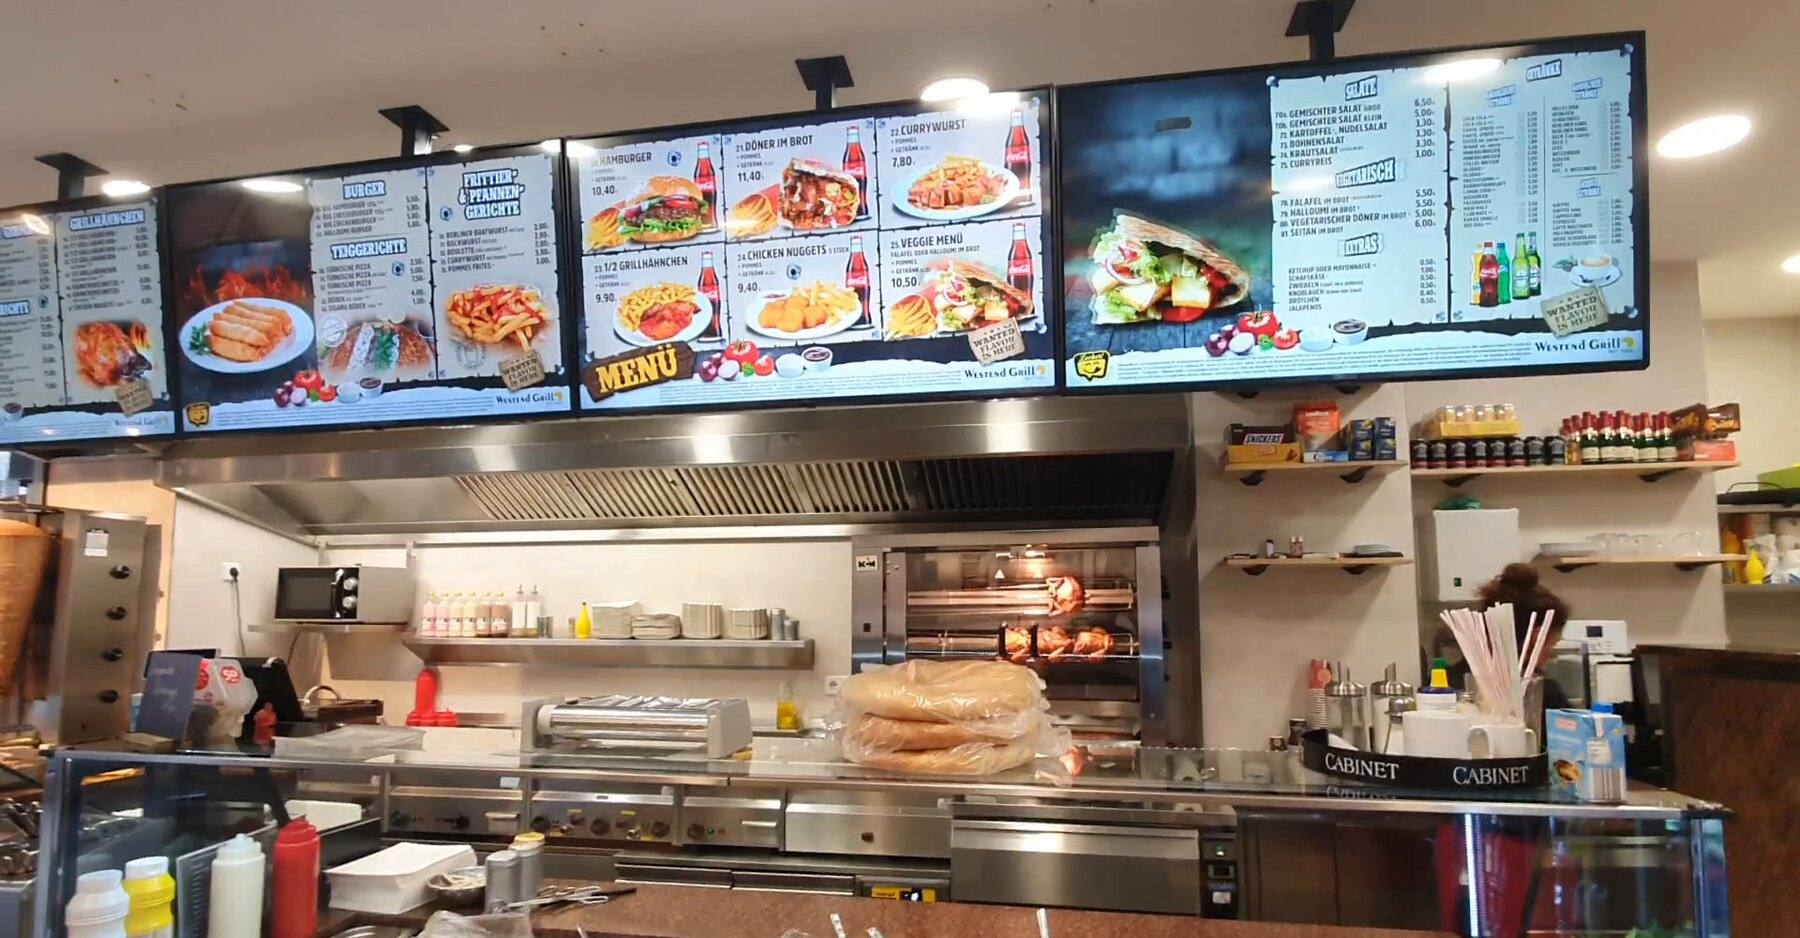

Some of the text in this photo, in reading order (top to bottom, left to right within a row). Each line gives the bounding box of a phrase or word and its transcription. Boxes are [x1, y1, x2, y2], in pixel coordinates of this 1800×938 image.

[1290, 106, 1336, 118] GEMISCHTER
[1338, 104, 1362, 114] SALAT
[901, 119, 966, 135] CURRYWURST
[1290, 116, 1337, 128] GEMISCHTER
[1338, 114, 1362, 124] SALAT
[1338, 123, 1388, 134] NUDELSALAT
[745, 138, 775, 151] DÖNER
[777, 140, 788, 148] IM
[790, 135, 813, 146] BROT
[1290, 136, 1344, 148] BOHNENSALAT
[600, 152, 652, 166] HAMBURGER
[1290, 147, 1338, 158] KRAUTSALAT
[1290, 158, 1332, 168] CURRYREIS
[344, 181, 385, 199] BURGER
[1290, 198, 1322, 206] FALAFEL
[466, 200, 520, 219] GERICHTE
[1290, 207, 1329, 216] HALLOUMI
[1290, 216, 1350, 226] VEGETARISCHER
[474, 226, 508, 236] BRATWURST
[1290, 228, 1316, 236] SEITAN
[901, 237, 934, 248] VEGGIE
[936, 232, 963, 246] MENÜ
[332, 240, 406, 258] TEIGGERICHTE
[748, 248, 784, 260] CHICKEN
[786, 245, 826, 256] NUGGETS
[448, 264, 472, 273] POMMES
[604, 263, 617, 272] 1/2
[620, 256, 688, 270] GRILLHÄHNCHEN
[1548, 296, 1596, 316] WANTED
[973, 328, 1016, 348] WANTED
[596, 344, 678, 394] MENÜ
[1245, 434, 1282, 444] SNICKERS
[1325, 753, 1399, 780] CABINET
[1452, 766, 1530, 785] CABINET
